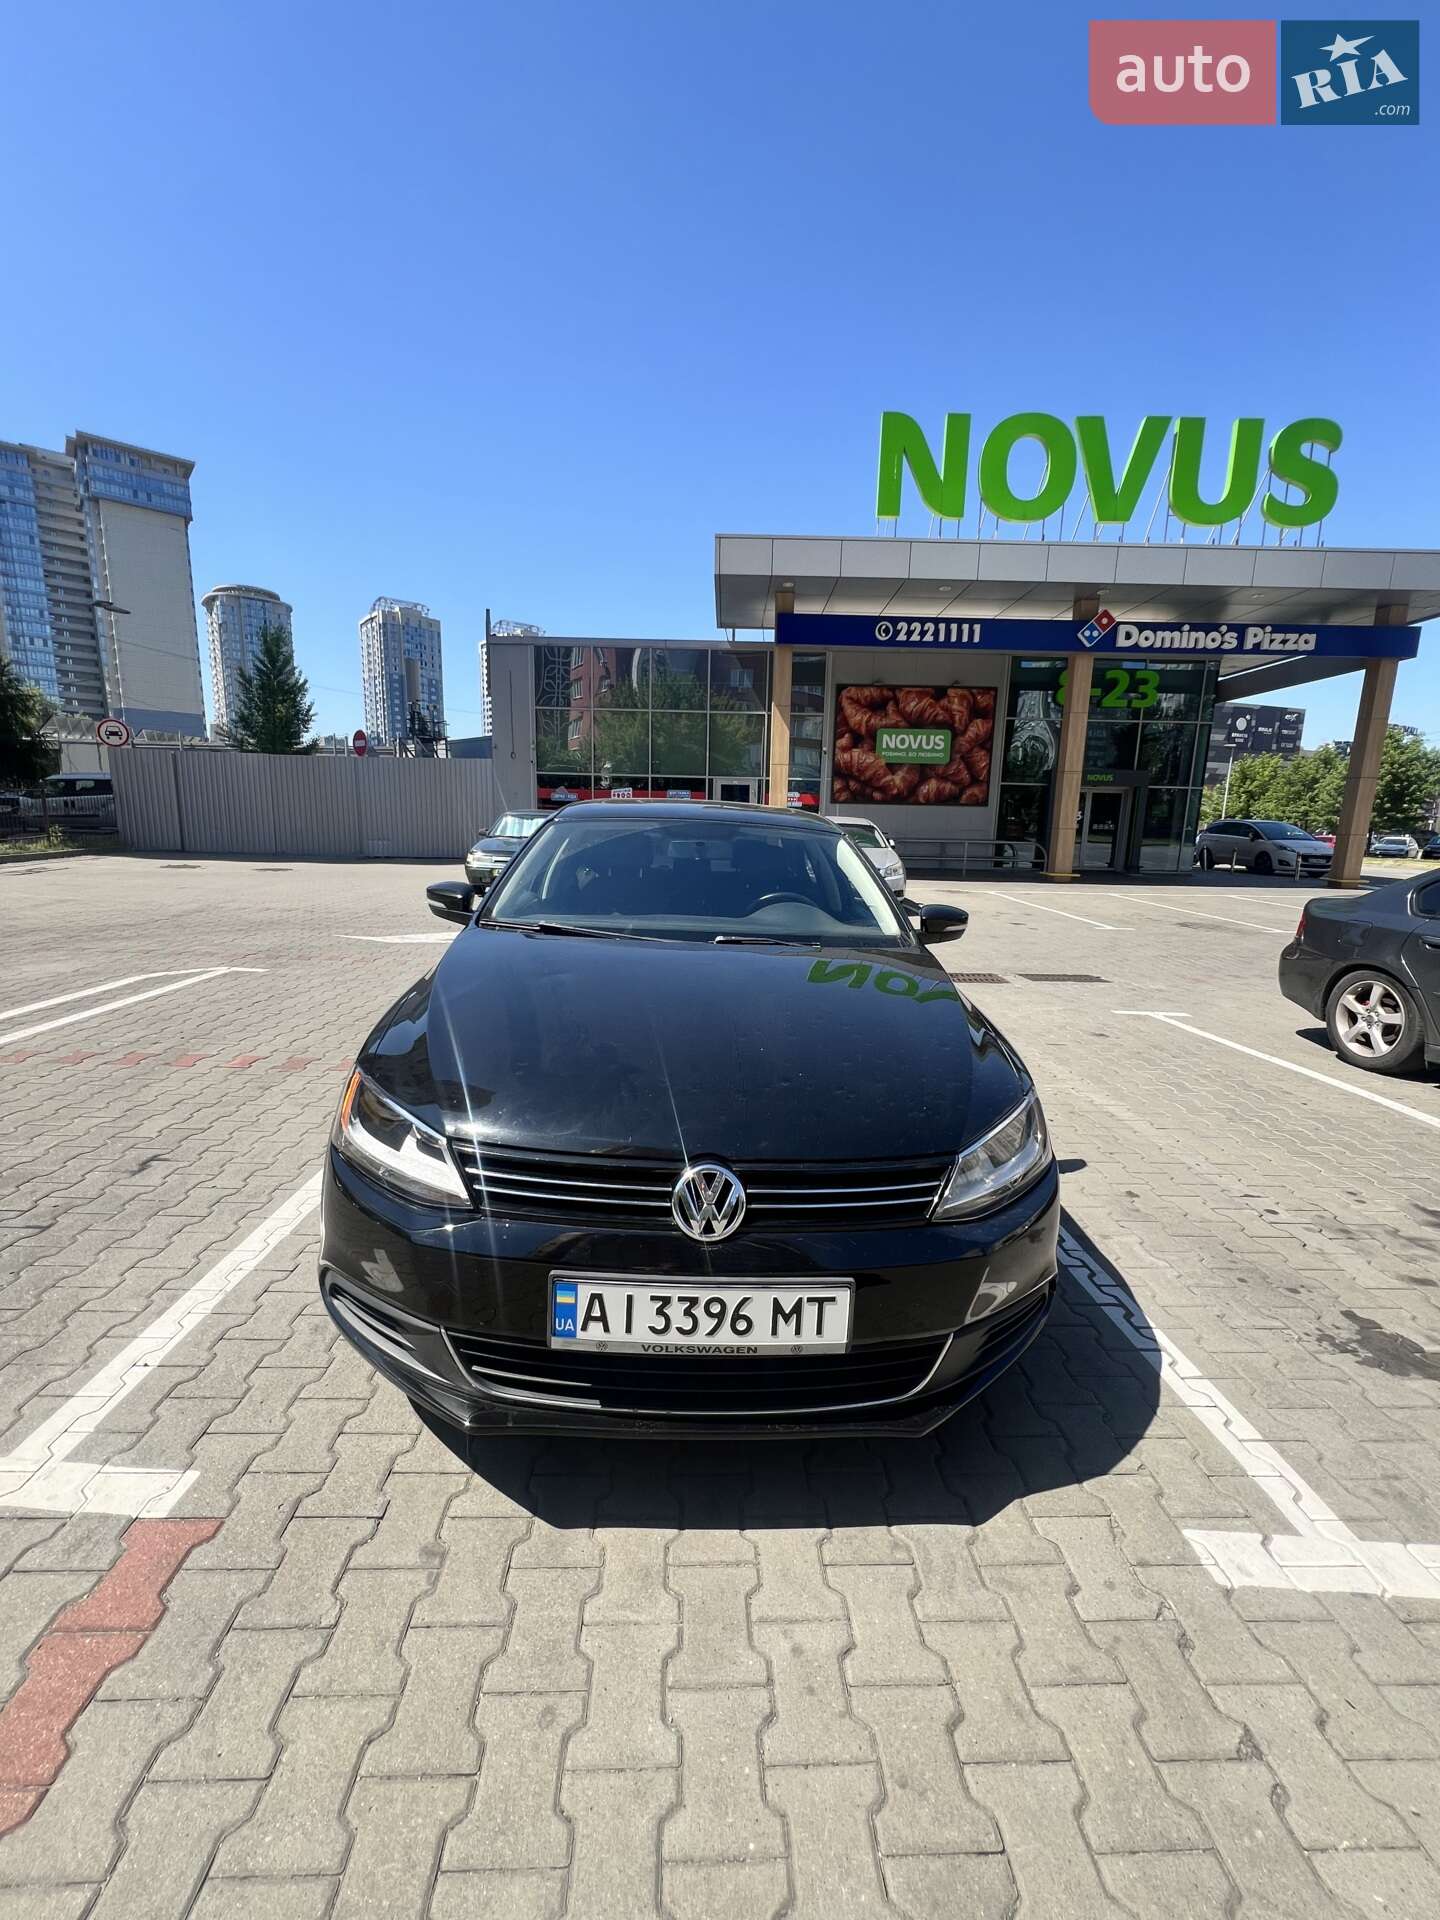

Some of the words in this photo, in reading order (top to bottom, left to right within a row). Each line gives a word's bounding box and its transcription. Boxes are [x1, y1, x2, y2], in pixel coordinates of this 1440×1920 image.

[876, 410, 1343, 528] NOVUS
[895, 621, 981, 643] 2221111
[1115, 624, 1239, 650] Domino's
[1243, 625, 1317, 651] Pizza
[882, 733, 945, 750] NOVUS
[555, 1318, 574, 1332] UA
[580, 1292, 634, 1334] AI
[647, 1294, 755, 1337] 3396
[770, 1295, 837, 1337] MT
[641, 1343, 758, 1355] VOLKSWAGEN
